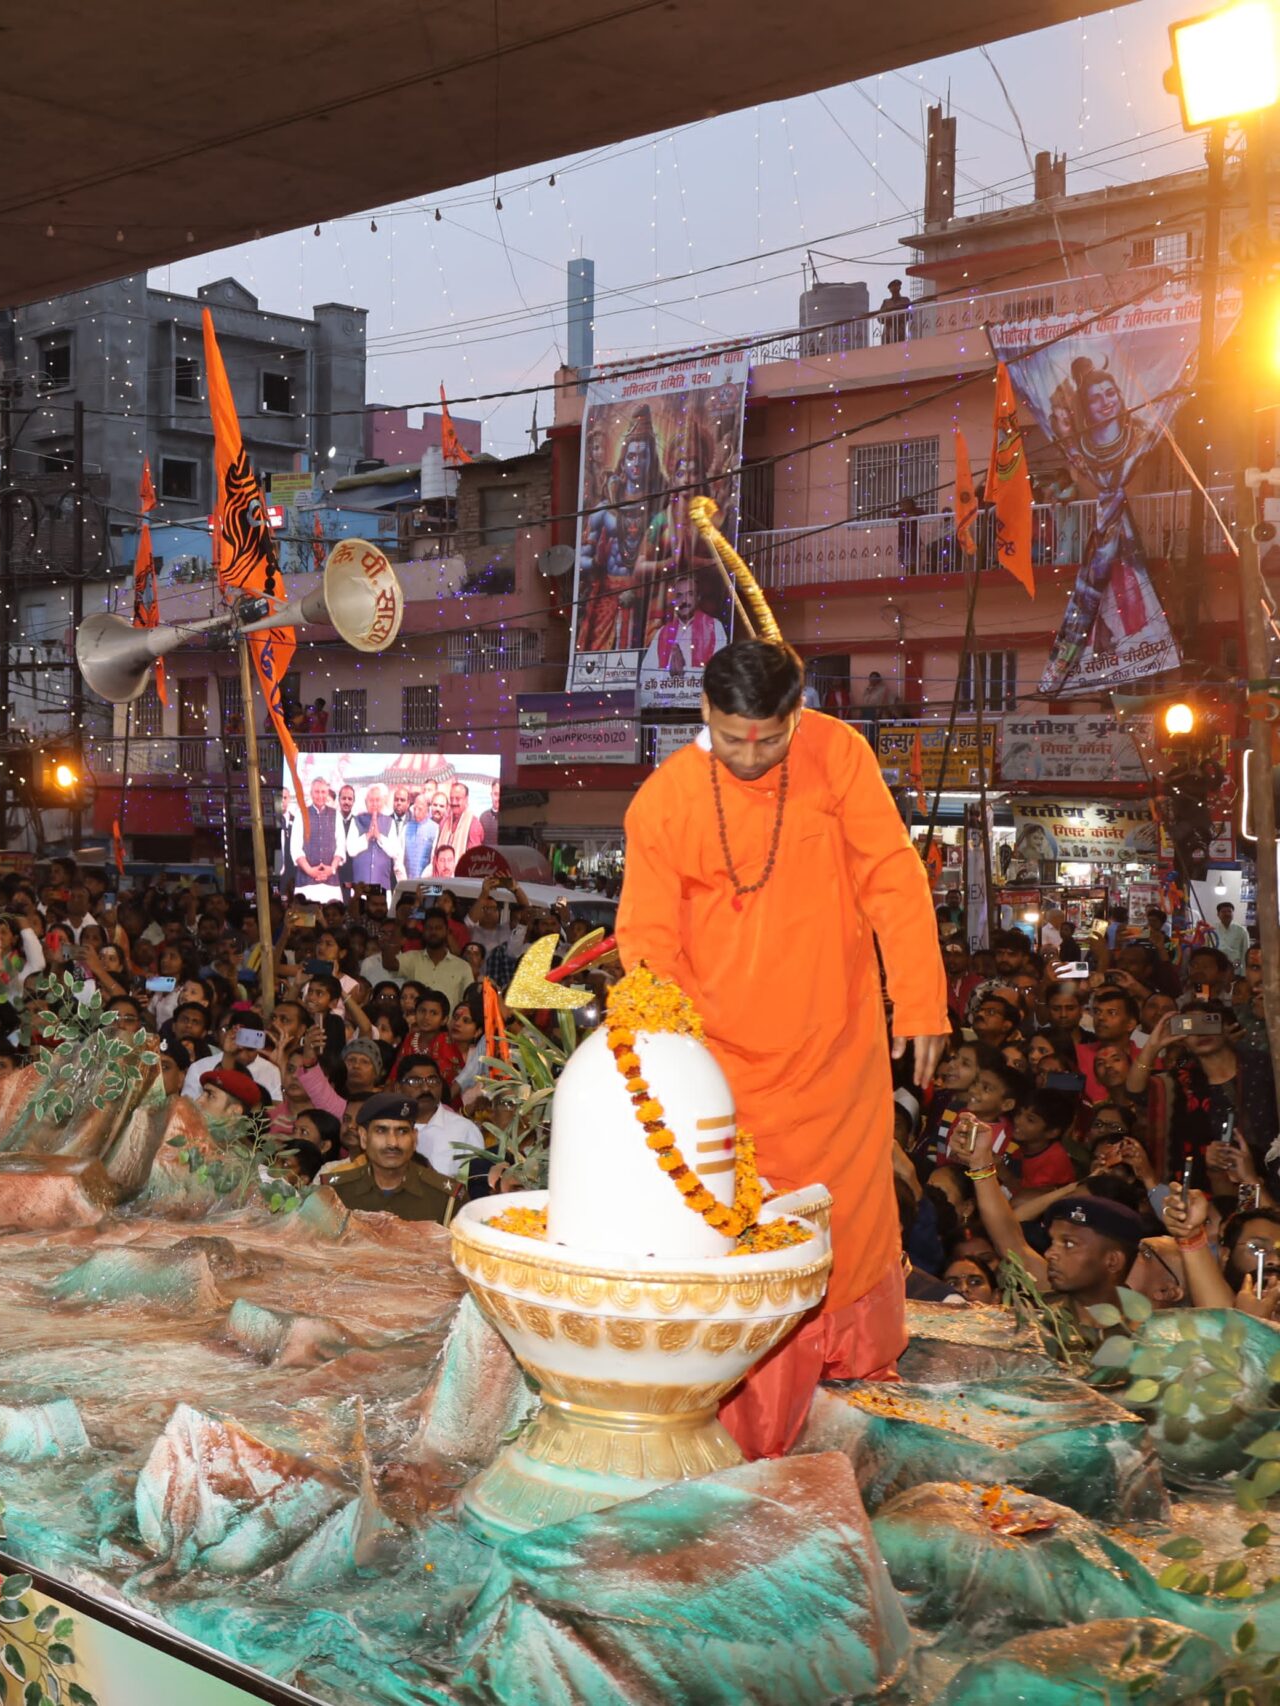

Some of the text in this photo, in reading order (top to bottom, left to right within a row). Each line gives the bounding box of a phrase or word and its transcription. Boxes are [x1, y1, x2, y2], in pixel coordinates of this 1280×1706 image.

[1007, 719, 1078, 736] सतीश
[1017, 804, 1086, 819] सतीश
[1052, 824, 1086, 838] गिफ्ट
